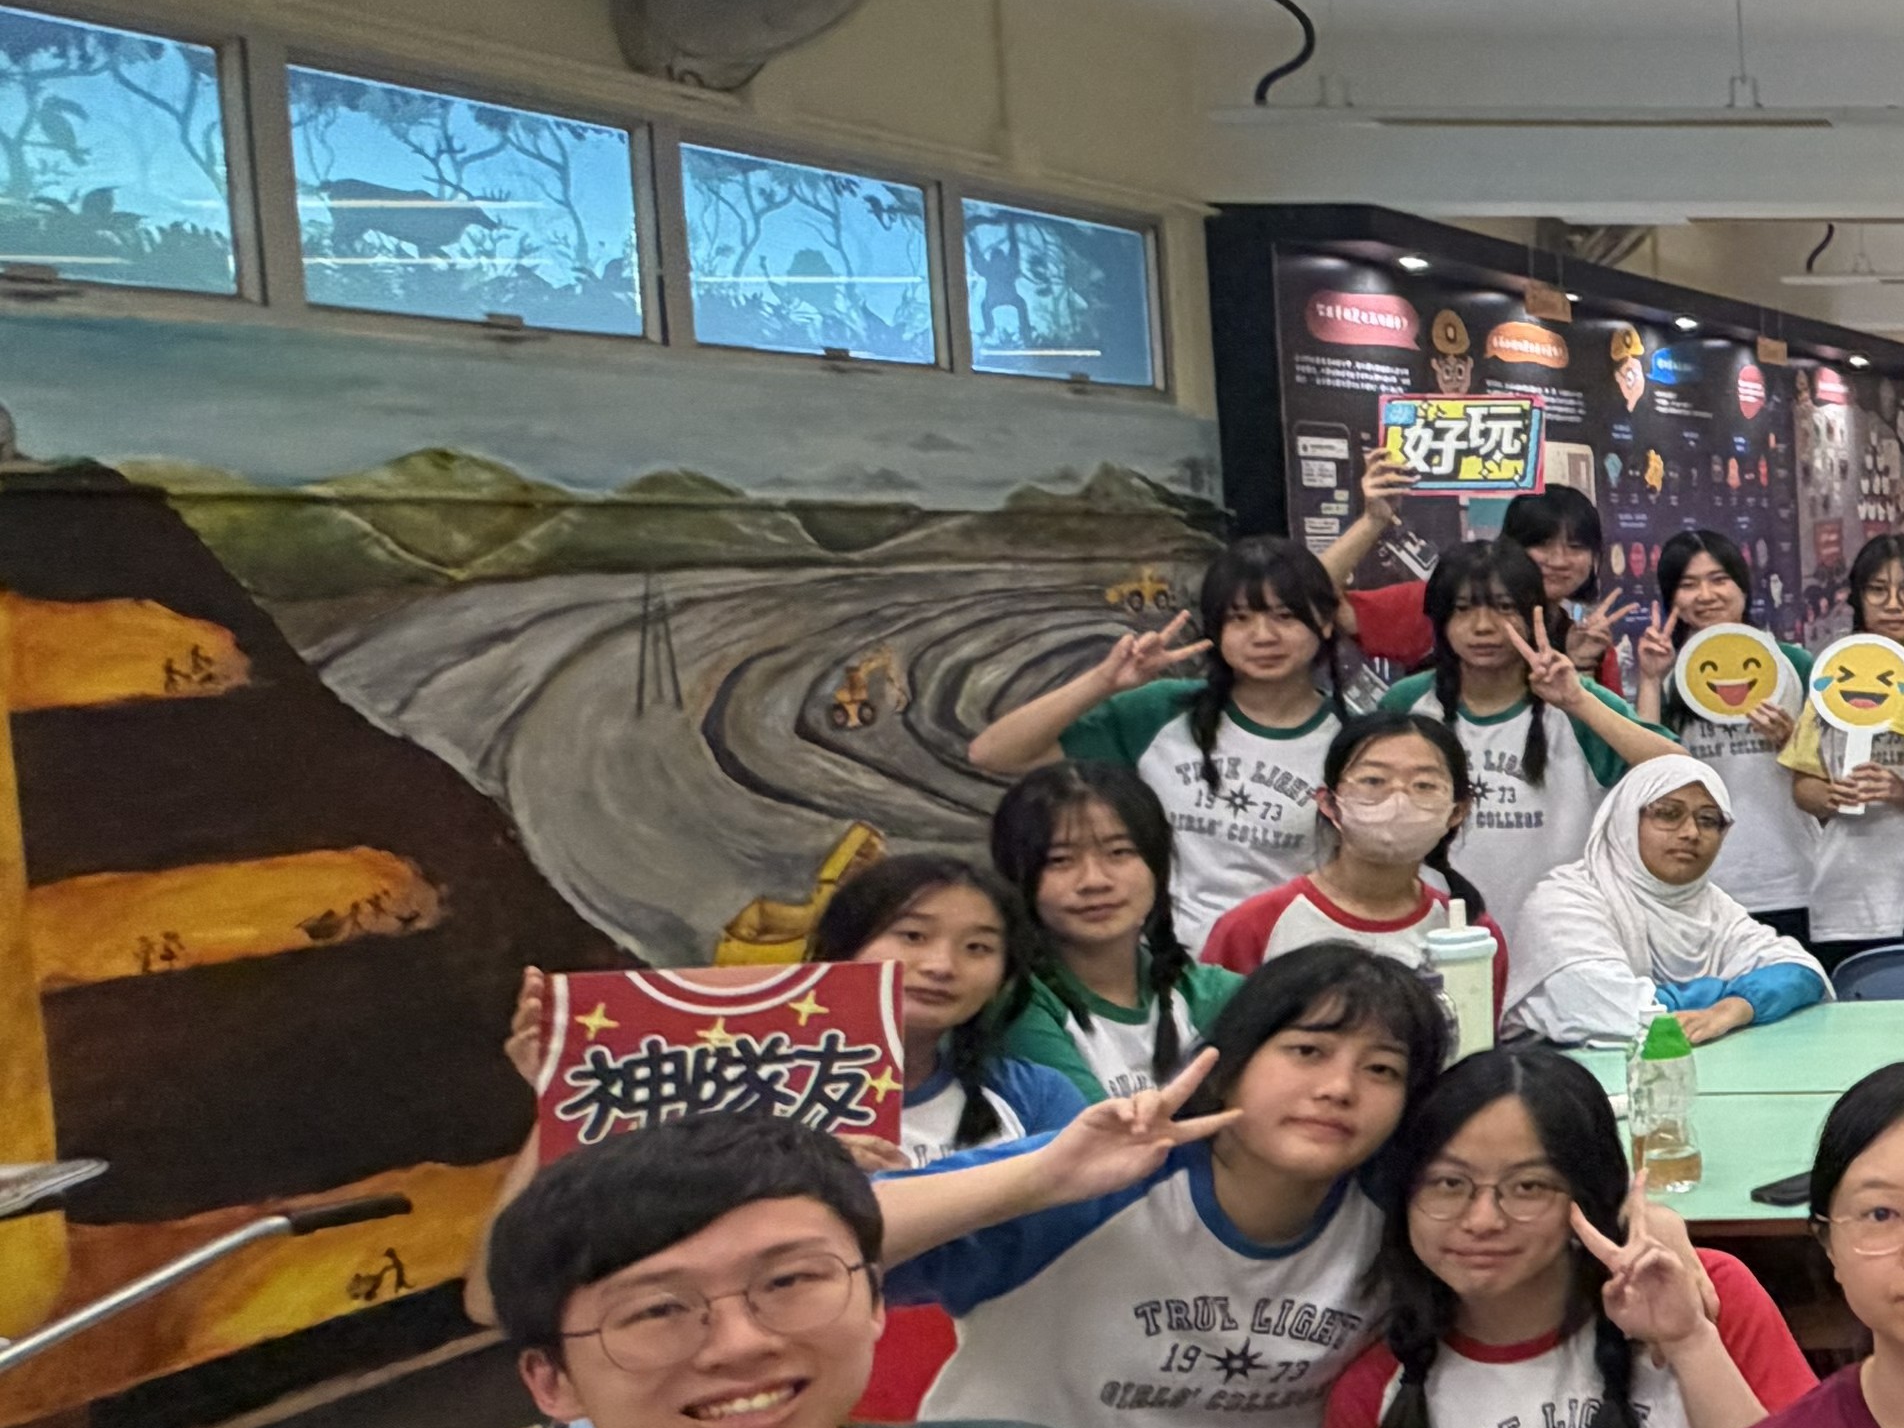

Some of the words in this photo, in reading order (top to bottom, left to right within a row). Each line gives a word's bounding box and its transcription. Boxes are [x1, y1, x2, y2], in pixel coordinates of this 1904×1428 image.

[1403, 405, 1524, 475] 好玩
[1498, 785, 1517, 804] 73
[1259, 800, 1283, 822] 73
[1475, 810, 1544, 829] COLLEGE
[556, 1029, 881, 1145] 神隊友
[1250, 1297, 1363, 1351] LIGHT
[1159, 1342, 1202, 1374] 19
